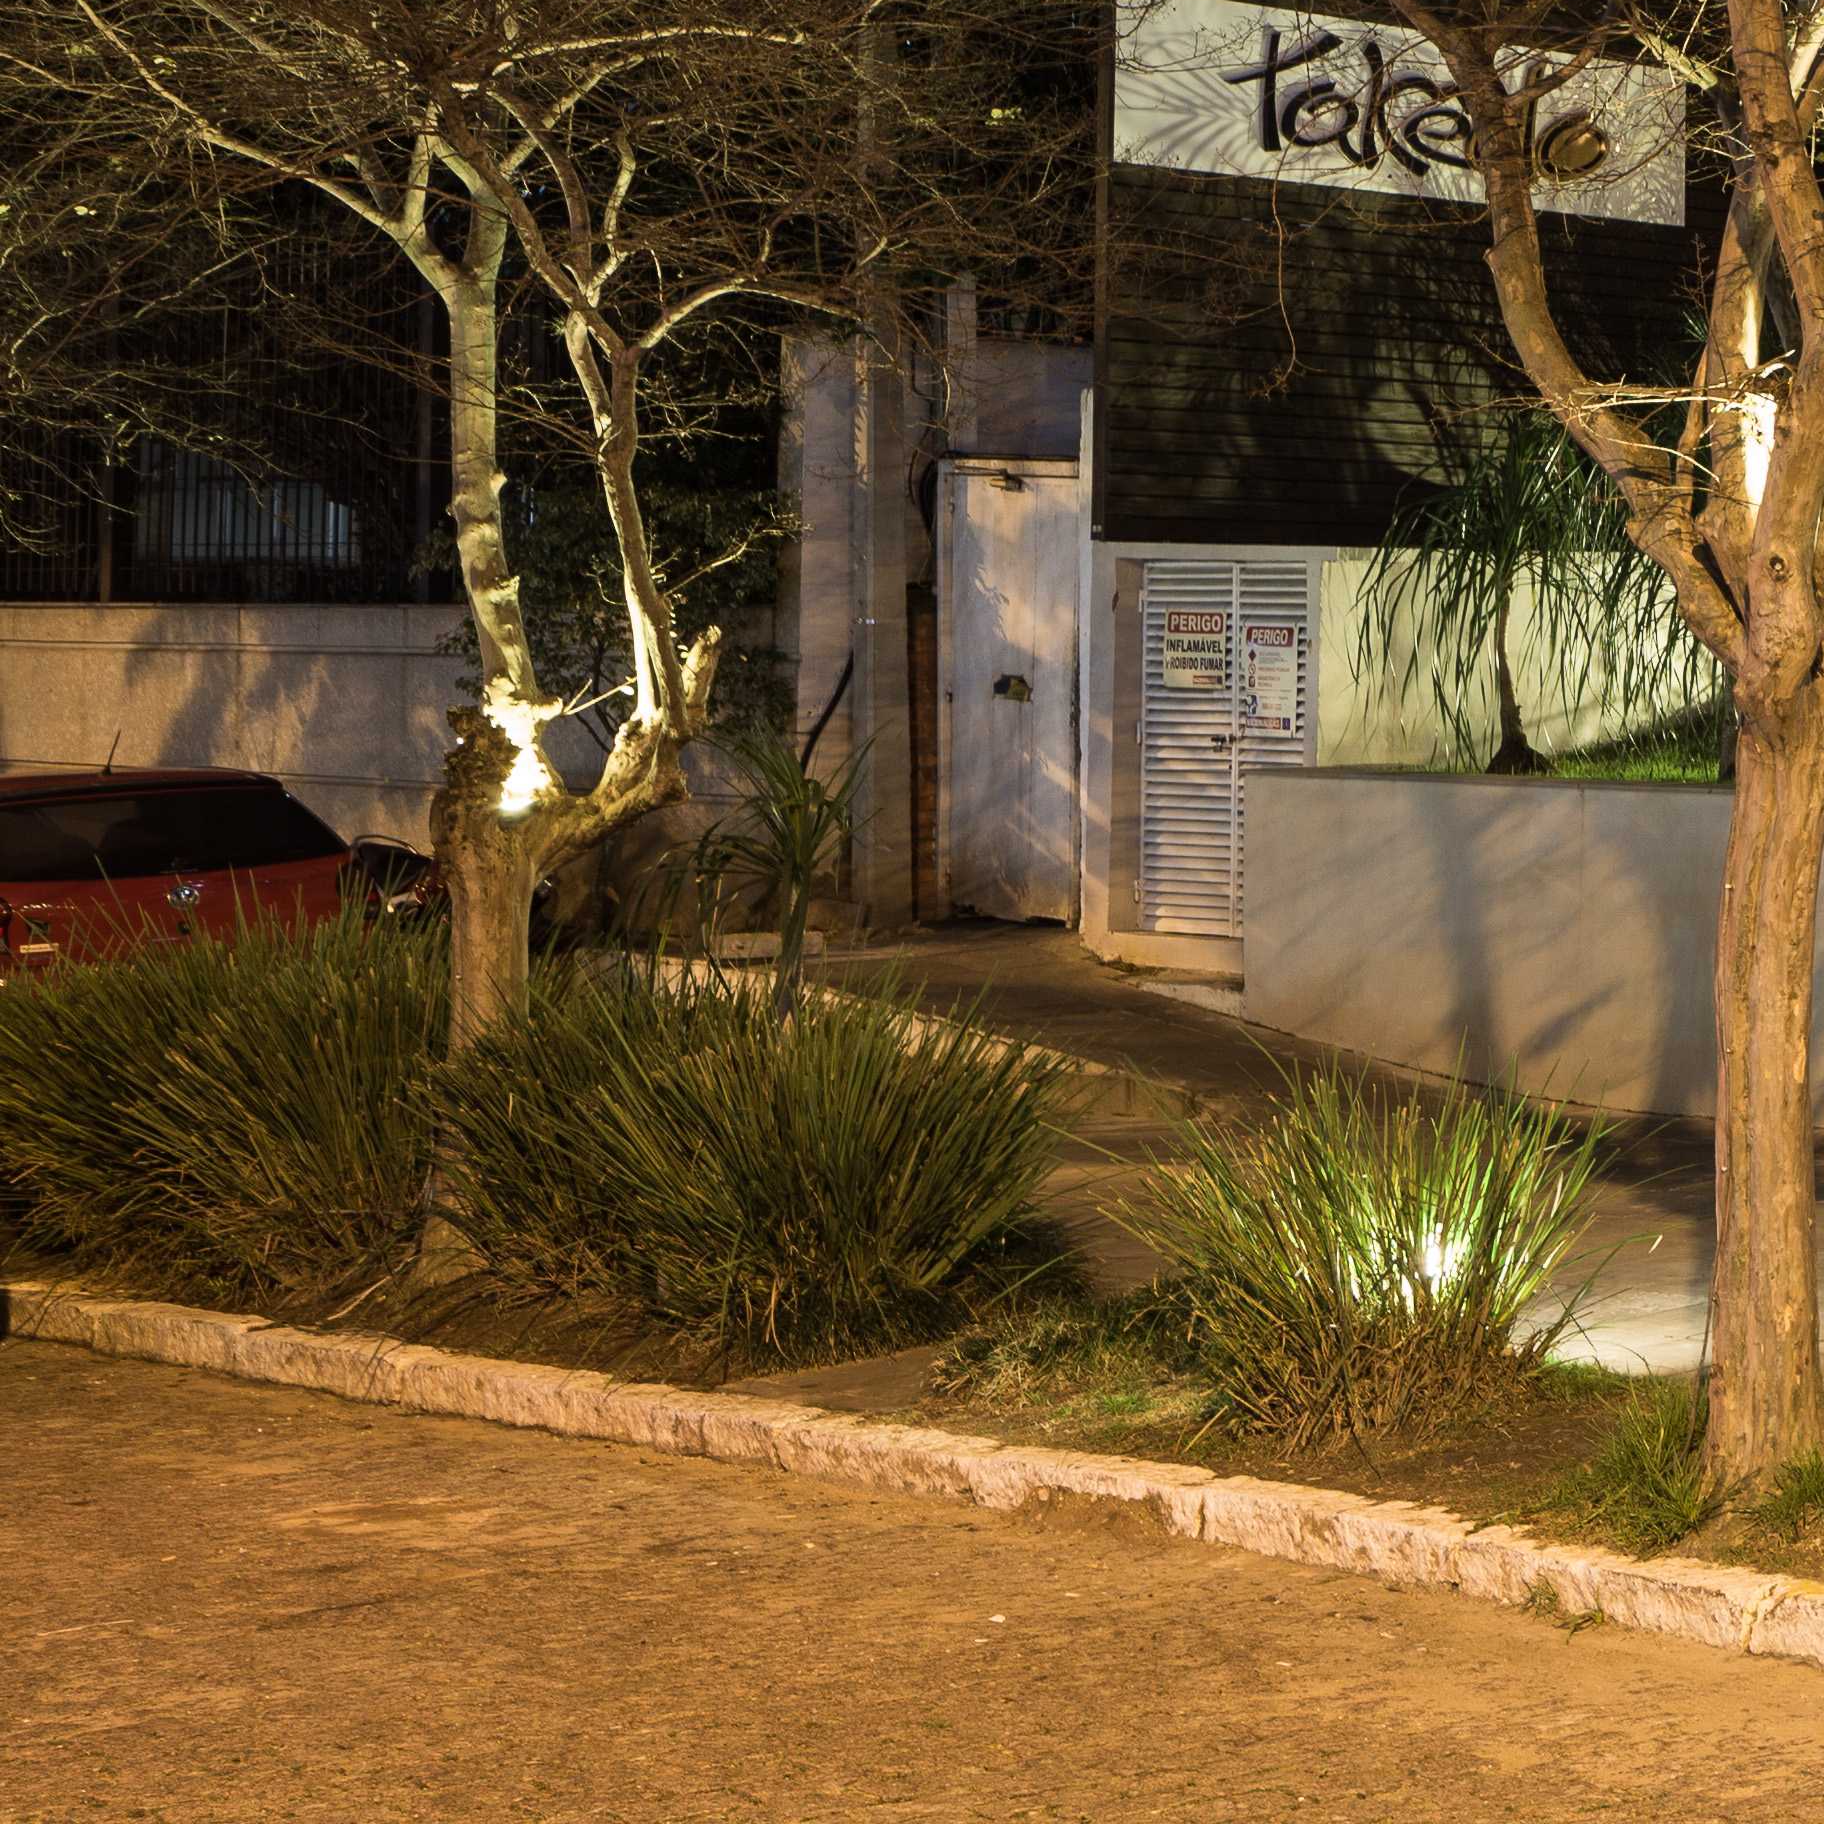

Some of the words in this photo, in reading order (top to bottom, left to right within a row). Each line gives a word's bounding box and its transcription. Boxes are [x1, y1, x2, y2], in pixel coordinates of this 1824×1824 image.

[1170, 614, 1222, 632] PERIGO
[1166, 637, 1223, 653] INFLAMÁVEL
[1251, 629, 1288, 645] PERIGO
[1200, 657, 1223, 671] FUMAR
